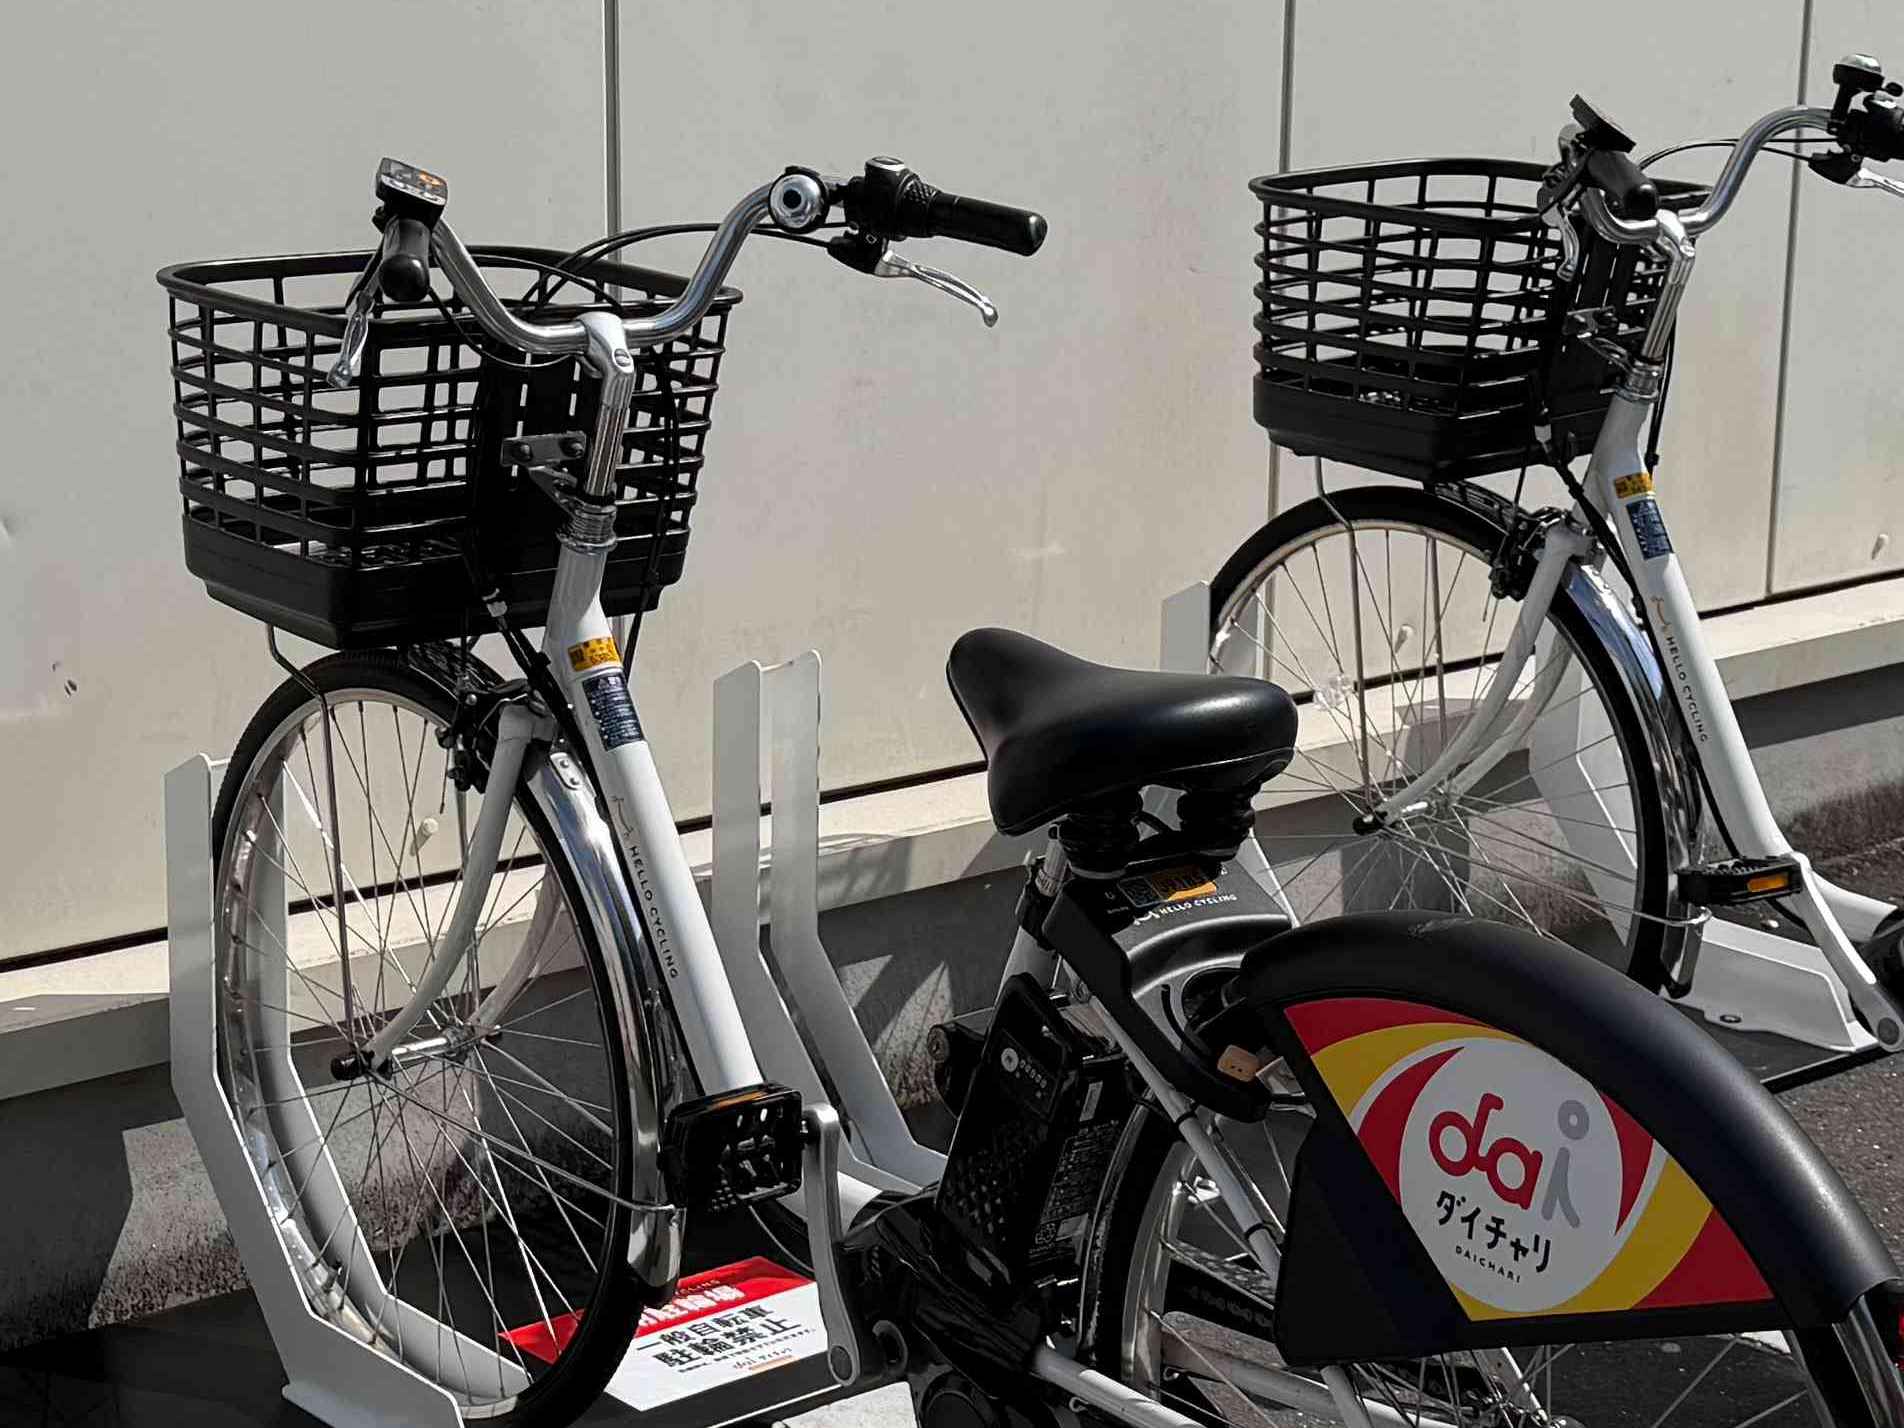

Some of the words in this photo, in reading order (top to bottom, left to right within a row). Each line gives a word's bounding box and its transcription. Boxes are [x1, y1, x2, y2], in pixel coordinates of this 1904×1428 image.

[1666, 636, 1687, 681] HELLO
[1683, 685, 1708, 743] CYCLING
[629, 845, 653, 901] HELLO
[650, 907, 679, 979] CYCLING
[1428, 1092, 1589, 1229] dai
[1435, 1189, 1551, 1273] ダイチャリ
[1455, 1245, 1521, 1284] DAICHARI
[636, 1304, 773, 1351] 一般自転車
[653, 1316, 801, 1369] 駐輪禁止
